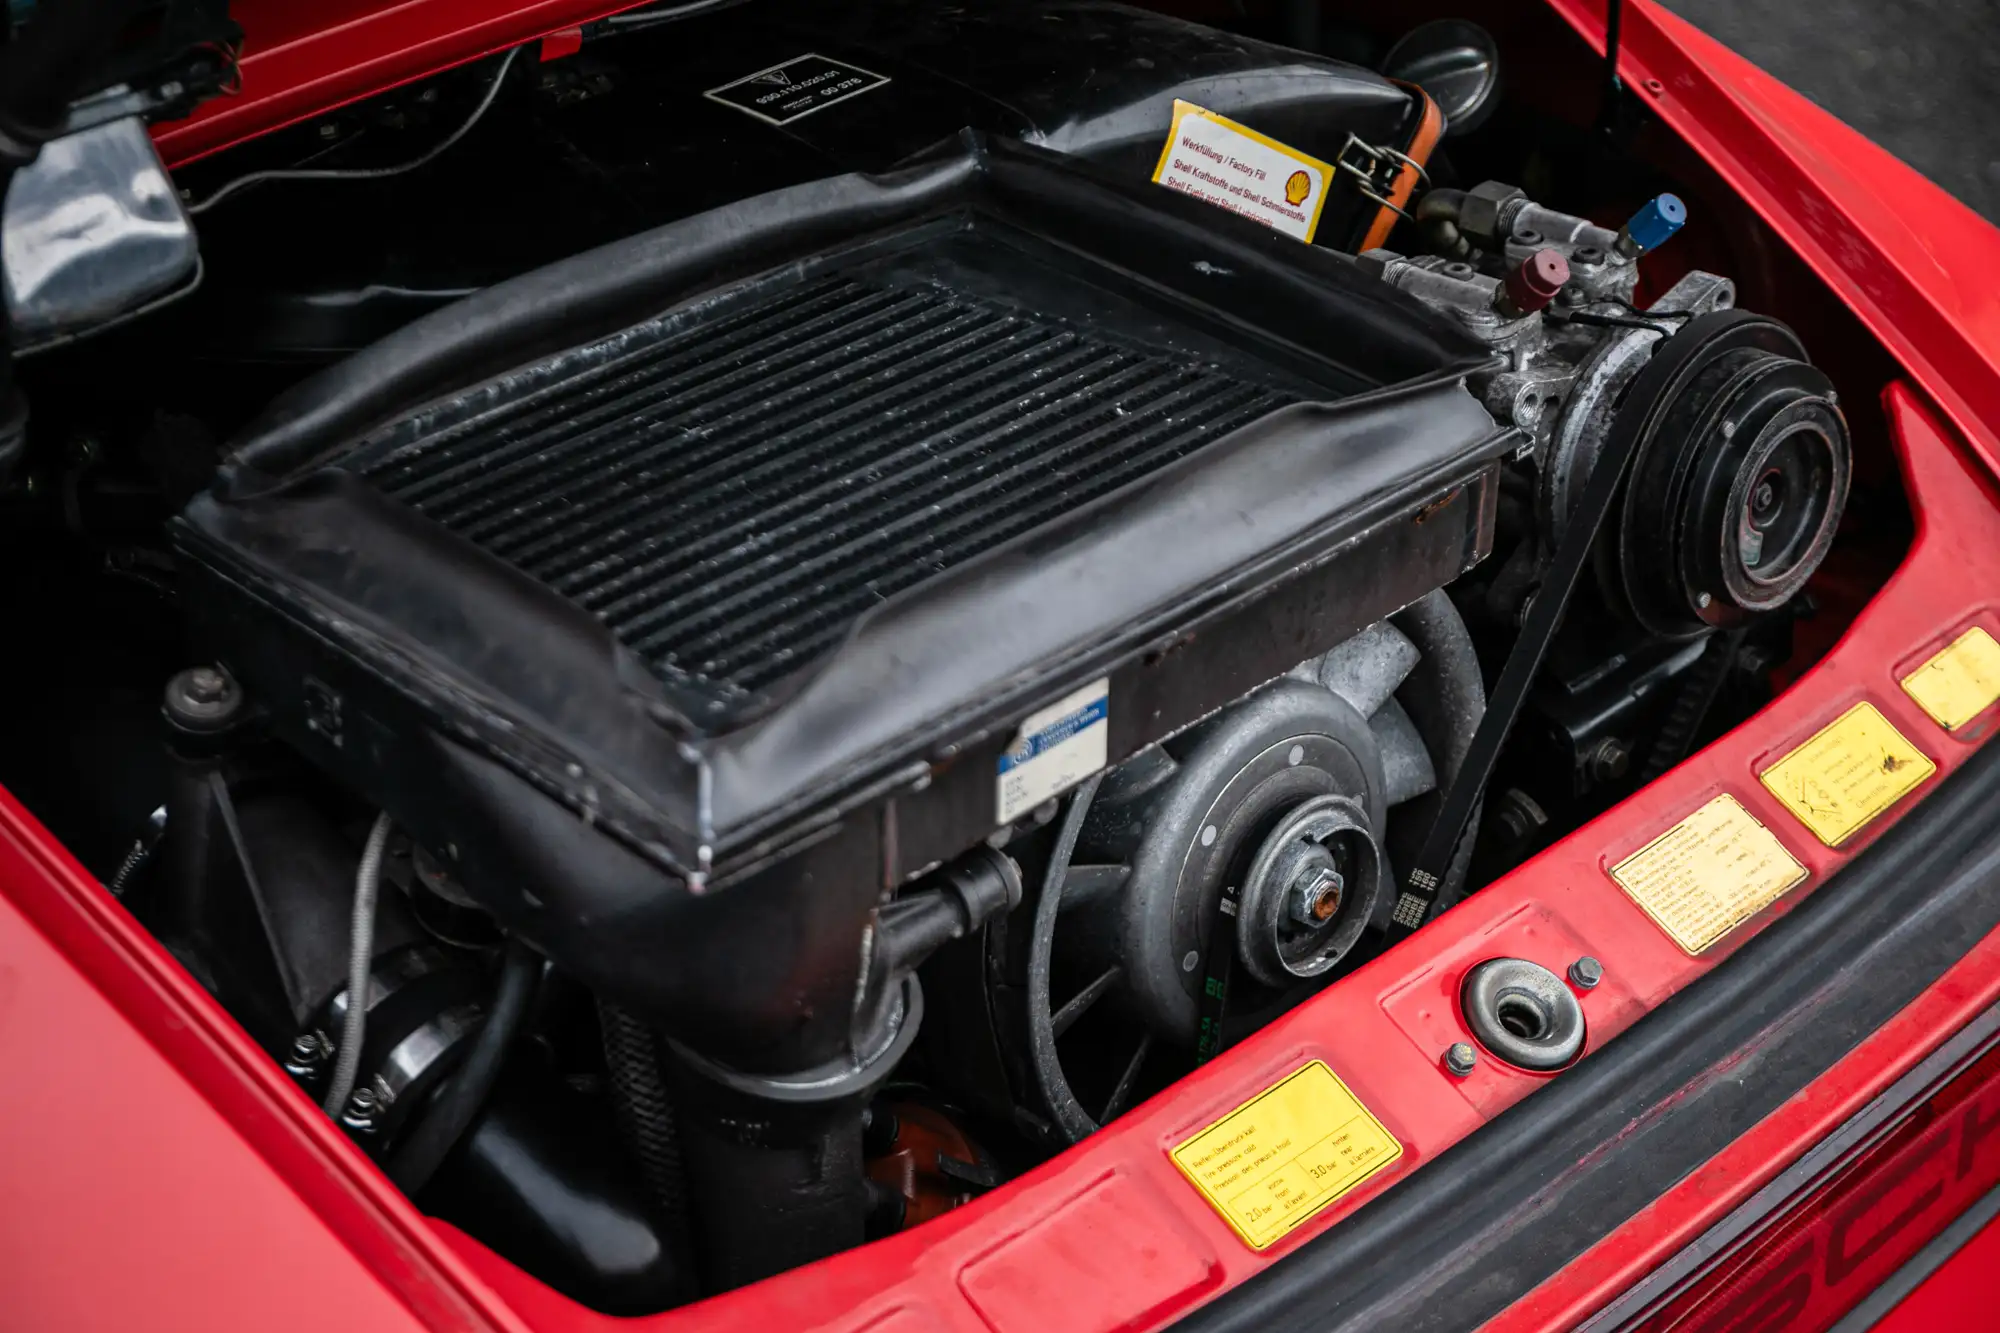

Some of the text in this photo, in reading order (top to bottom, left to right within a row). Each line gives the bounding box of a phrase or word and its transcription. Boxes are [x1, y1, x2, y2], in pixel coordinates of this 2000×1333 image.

[1182, 136, 1223, 163] Werkfüllung
[1229, 158, 1254, 177] Factory
[1255, 169, 1267, 180] Fill
[1167, 177, 1185, 191] Shell
[1174, 159, 1306, 223] Shell Kraftstoffe und Shell Schmierstoffe
[1419, 872, 1431, 889] 160
[1426, 875, 1438, 891] 161
[1243, 1143, 1257, 1154] cold
[1340, 1145, 1353, 1156] rear
[1310, 1161, 1337, 1180] 3.0 bar
[1245, 1203, 1274, 1222] 2.0 bar
